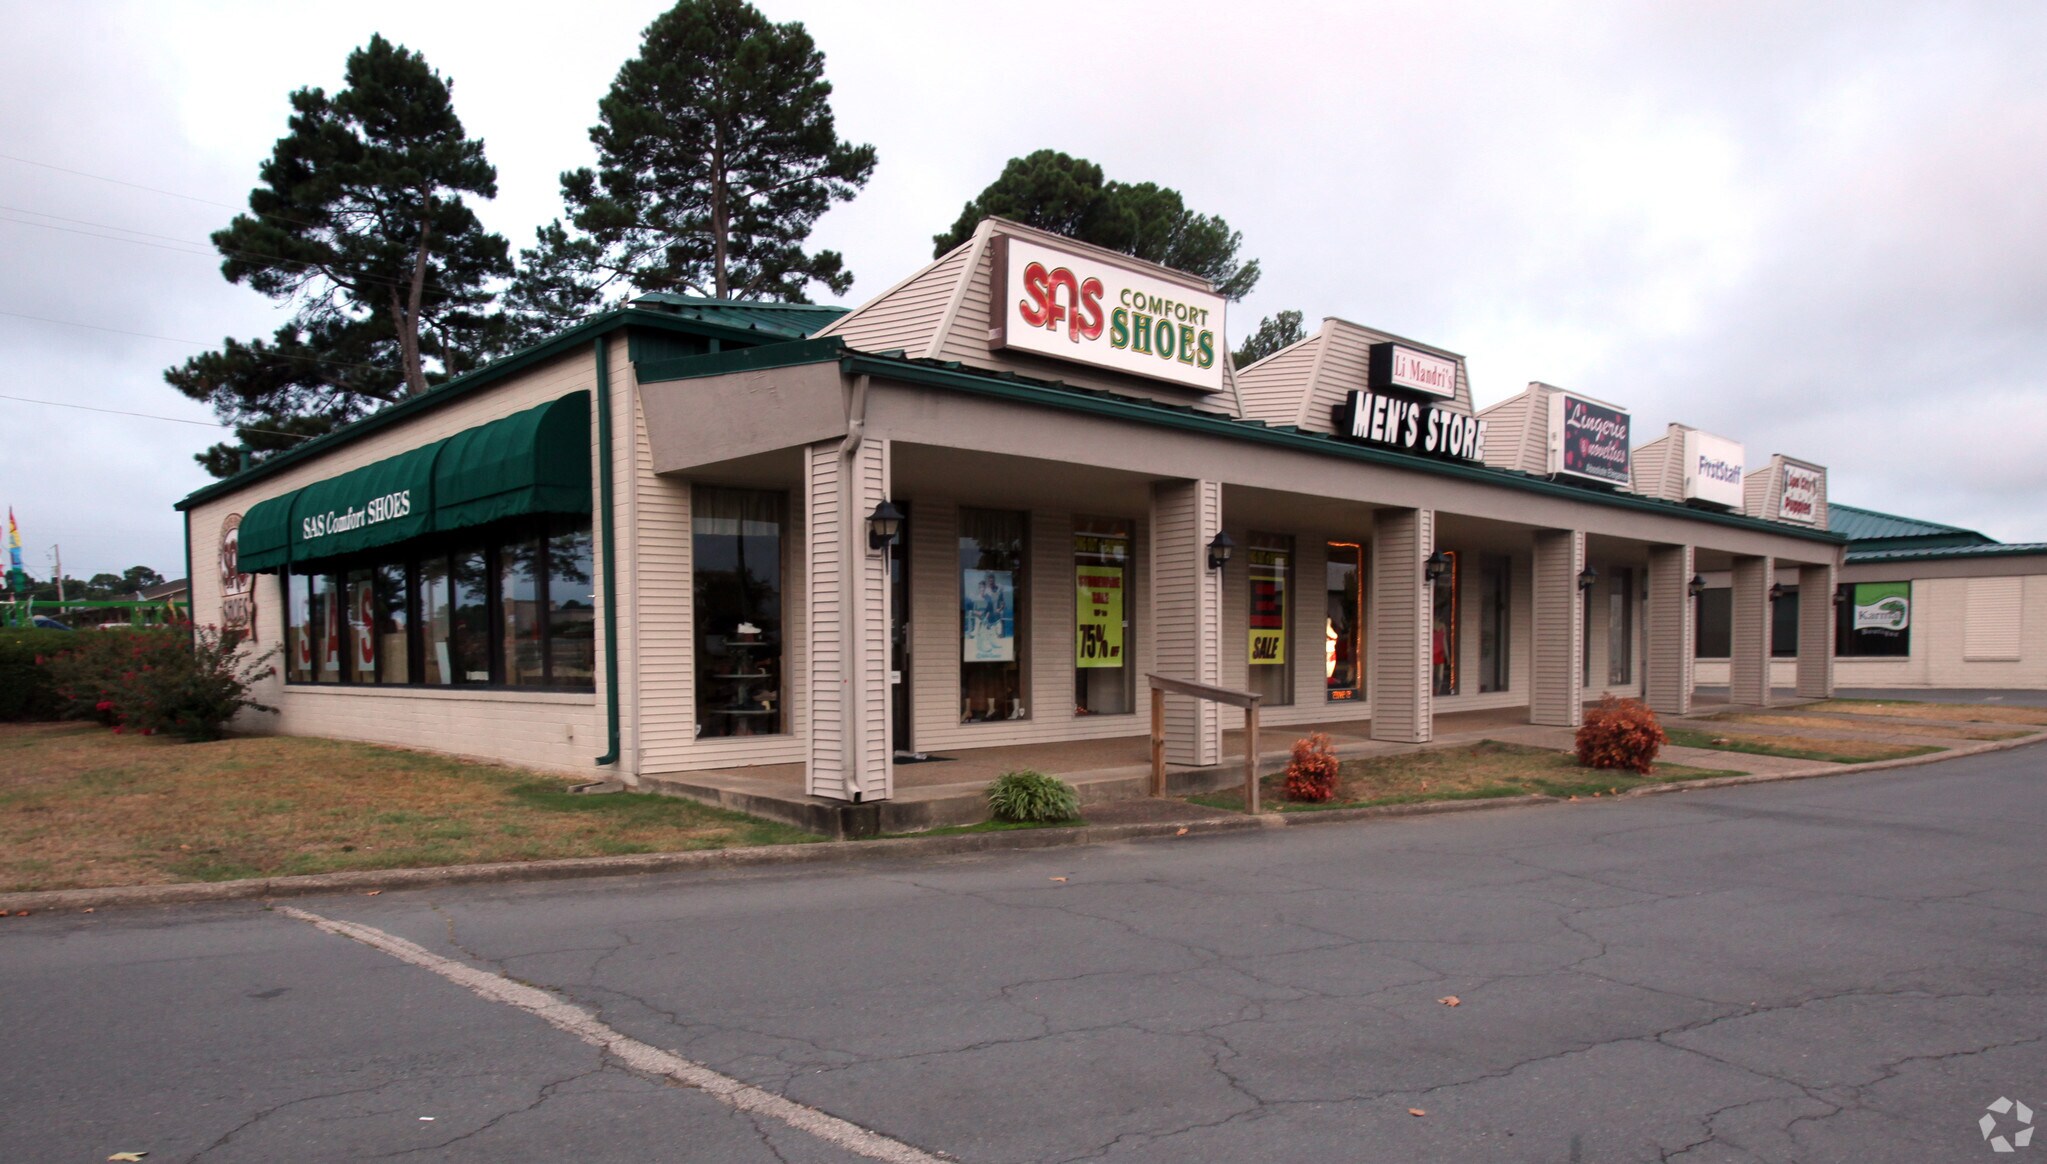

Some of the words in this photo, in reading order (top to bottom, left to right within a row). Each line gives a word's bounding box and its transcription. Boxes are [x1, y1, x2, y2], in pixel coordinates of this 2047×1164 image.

[1019, 261, 1105, 343] SAS
[1120, 288, 1209, 326] COMFORT
[1110, 306, 1215, 369] SHOES
[1394, 355, 1406, 377] Li
[1409, 359, 1454, 390] Mandri's
[1352, 390, 1420, 448] MEN'S
[1425, 408, 1489, 461] STORE
[1567, 403, 1627, 442] Lingerie
[303, 513, 325, 540] SAS
[326, 506, 366, 535] Comfort
[367, 489, 411, 525] SHOES
[1858, 610, 1901, 620] Karma
[1079, 624, 1108, 658] 75%
[1252, 636, 1280, 660] SALE
